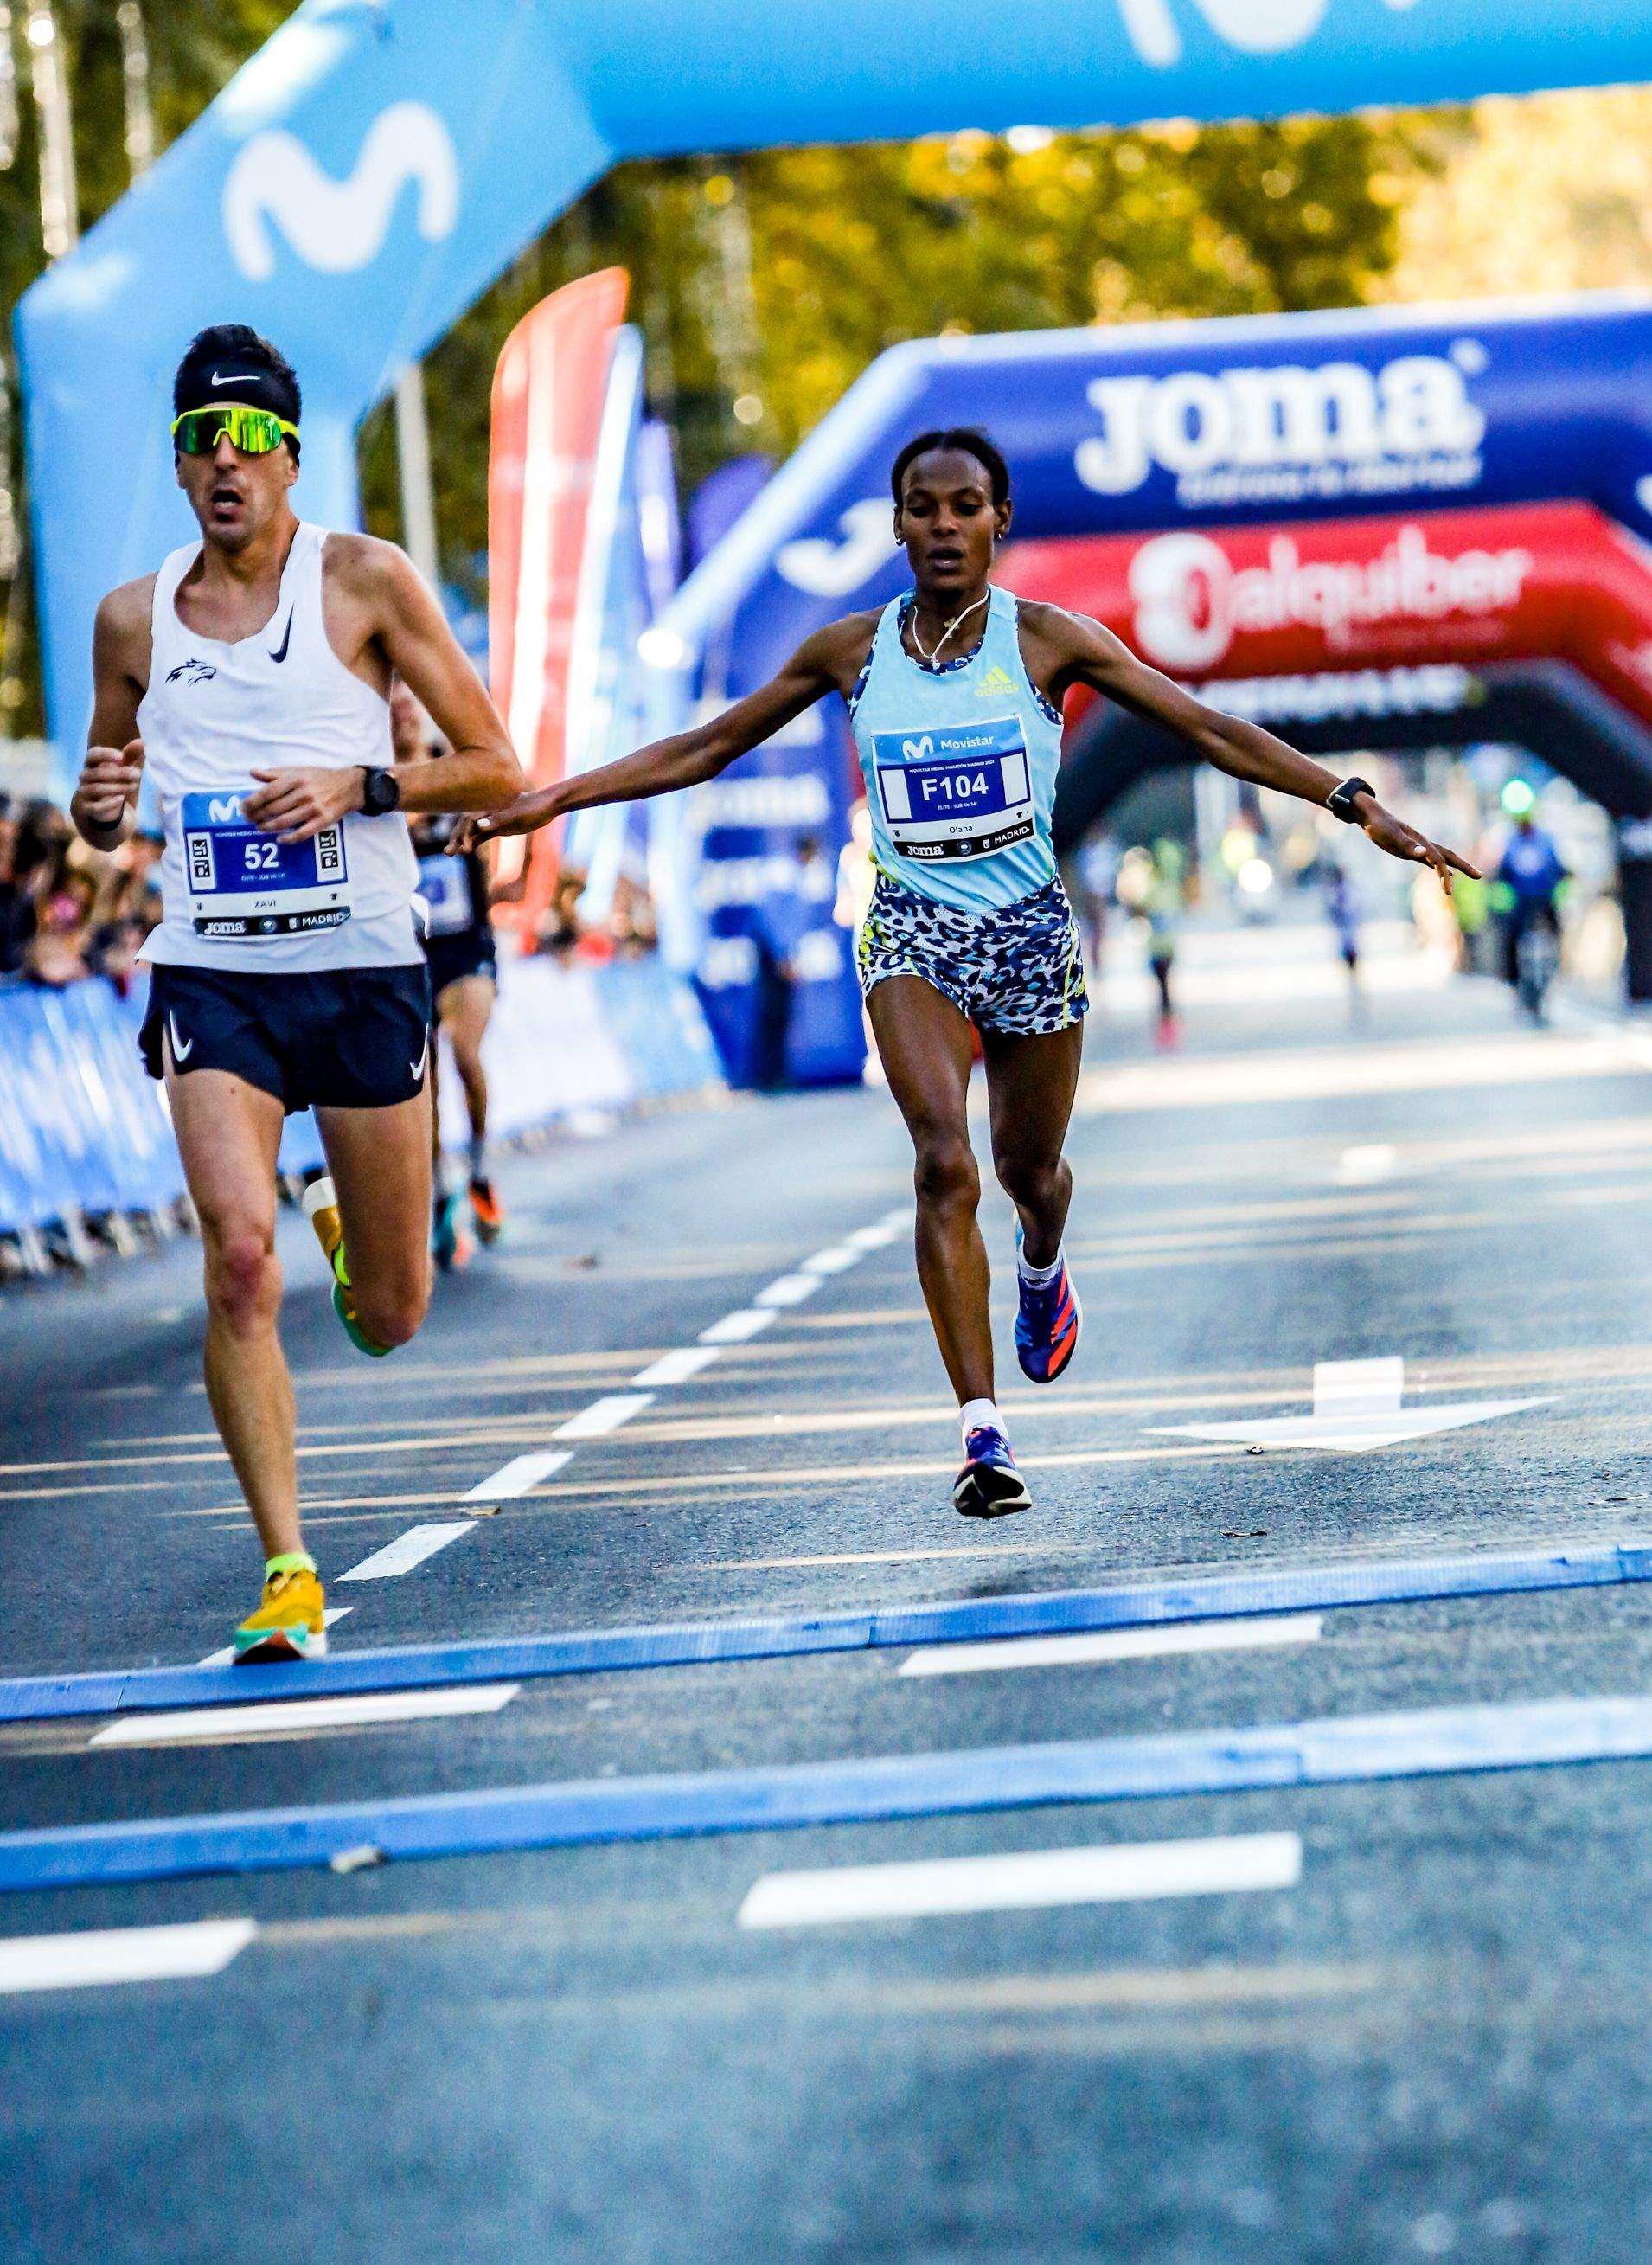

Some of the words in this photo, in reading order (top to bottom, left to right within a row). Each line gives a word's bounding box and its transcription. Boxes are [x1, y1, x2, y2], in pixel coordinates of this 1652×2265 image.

[941, 735, 994, 750] Movistar
[921, 773, 989, 801] F104
[949, 825, 973, 834] Olana
[994, 826, 1029, 845] MADRID
[244, 842, 279, 869] 52
[302, 912, 344, 927] MADRID
